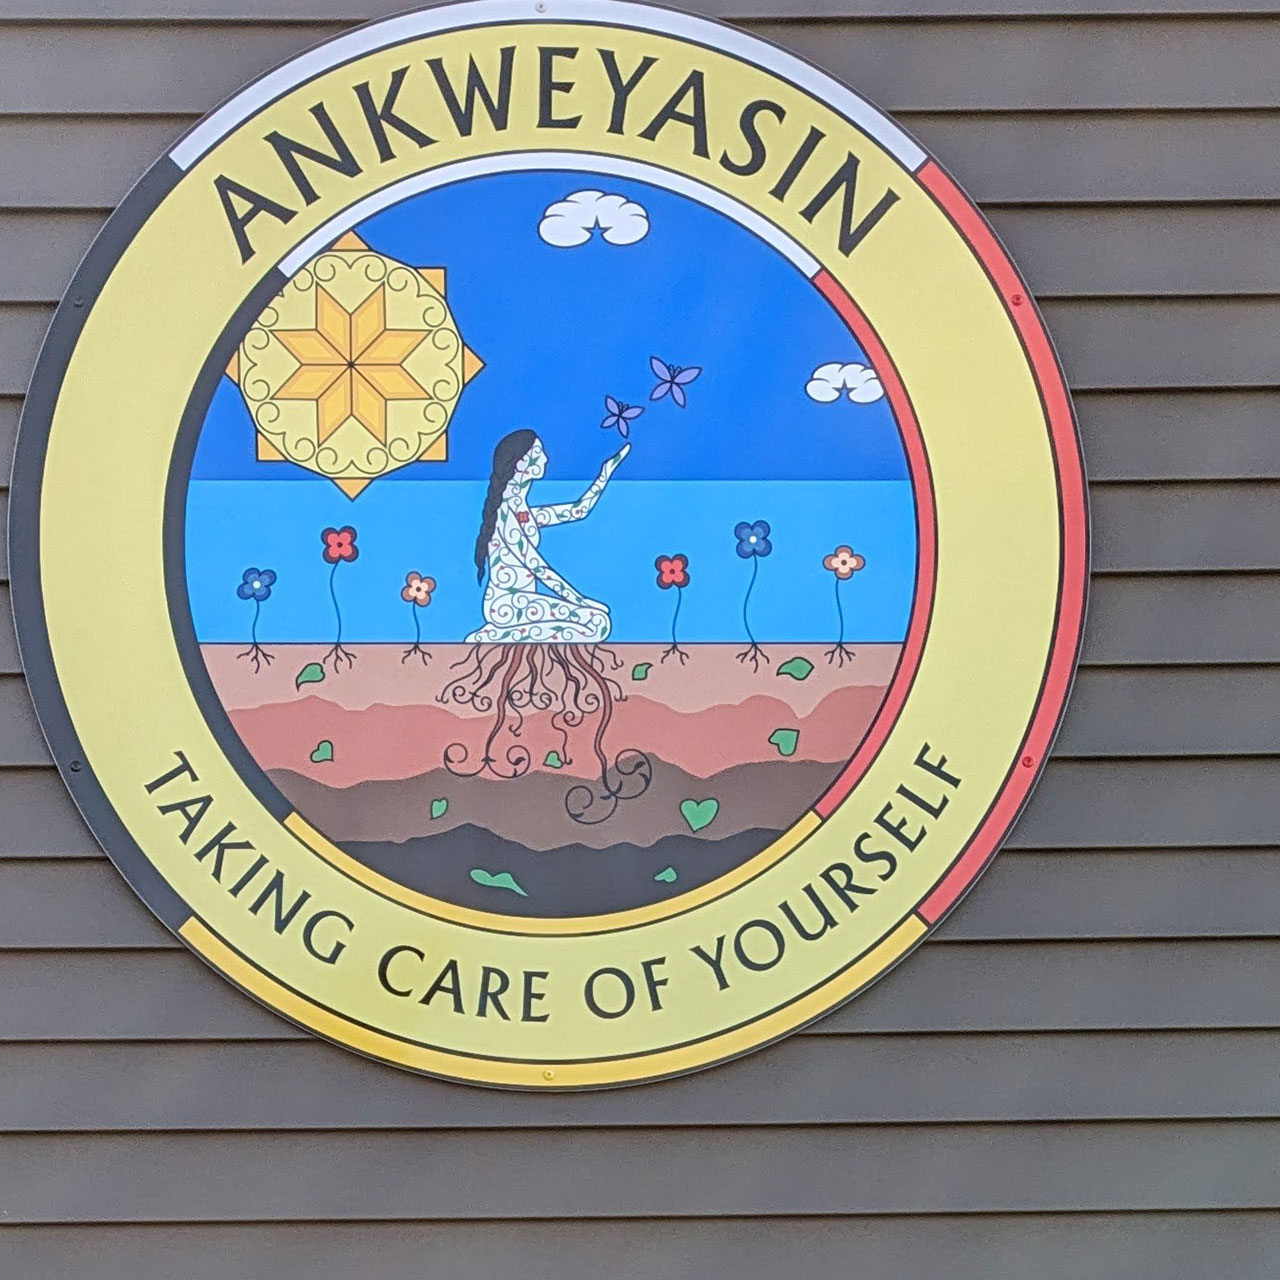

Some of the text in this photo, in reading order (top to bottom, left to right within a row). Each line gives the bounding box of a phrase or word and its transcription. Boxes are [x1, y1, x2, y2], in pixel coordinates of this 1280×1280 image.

[212, 45, 902, 265] ANKWEYASIN
[144, 742, 963, 1023] TAKING CARE OF YOURSELF
